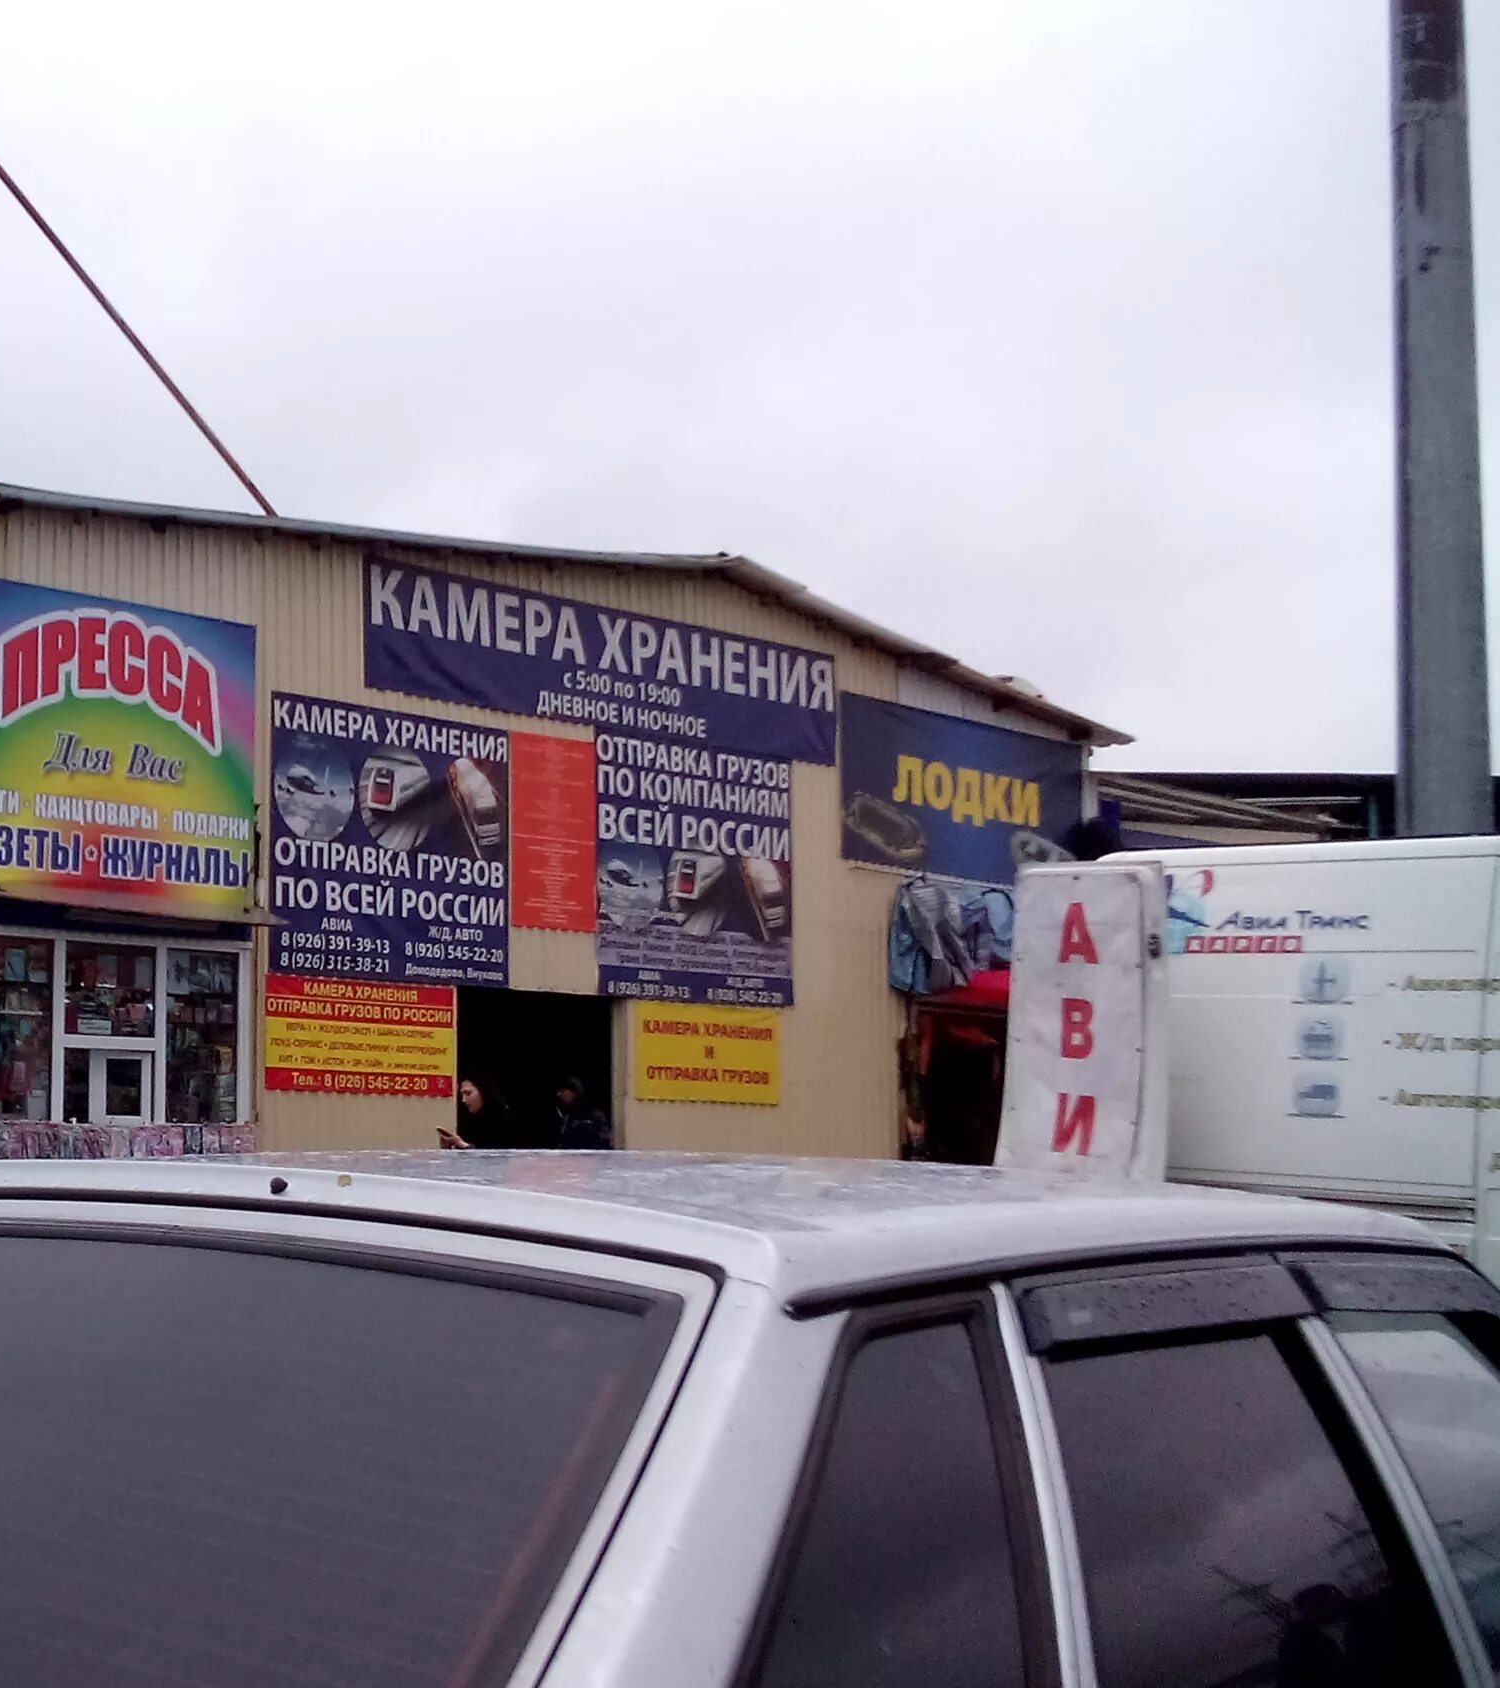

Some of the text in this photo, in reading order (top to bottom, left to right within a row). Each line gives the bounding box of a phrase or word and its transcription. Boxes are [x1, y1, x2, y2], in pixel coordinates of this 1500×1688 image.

[370, 564, 835, 713] КАМЕРА ХРАНЕНИЯ
[576, 670, 610, 695] 5:00
[614, 681, 635, 699] по
[639, 681, 680, 707] 19:00
[272, 699, 508, 763] КАМЕРА ХРАНЕНИЯ
[537, 691, 706, 739] ДНЕВНОЕ И НОЧНОЕ
[43, 731, 184, 782] Для Вас
[598, 733, 790, 789] ОТПРАВКА ГРУЗОВ
[598, 764, 634, 797] ПО
[640, 772, 790, 820] КОМПАНИЯМ
[892, 754, 1041, 828] ЛОДКИ
[35, 793, 158, 830] КАНЦТОВАРЫ
[171, 808, 249, 841] ПОДАРКИ
[599, 802, 790, 862] ВСЕЙ РОССИИ
[98, 836, 249, 888] ЖУРНАЛЫ
[273, 837, 411, 880] ОТПРАВКА
[417, 853, 504, 889] ГРУЗОВ
[274, 876, 505, 929] ПО ВСЕЙ РОССИИ
[281, 931, 390, 954] 8 (926) 391-39-13
[321, 917, 353, 932] АВИА
[454, 928, 483, 942] АВТО
[280, 952, 390, 973] 8 (926) 315-38-21
[405, 942, 503, 963] 8 (926) 545-22-20
[304, 981, 418, 1002] КАМЕРА ХРАНЕНИЯ
[616, 982, 640, 995] (926)
[267, 1000, 451, 1023] ОТПРАВКА ГРУЗОВ ПО РОССИИ
[643, 1019, 773, 1041] КАМЕРА ХРАНЕНИЯ
[704, 1045, 715, 1059] И
[324, 1073, 332, 1085] 8
[334, 1074, 365, 1089] (926)
[368, 1075, 428, 1090] 545-22-20
[646, 1065, 769, 1085] ОТПРАВКА ГРУЗОВ
